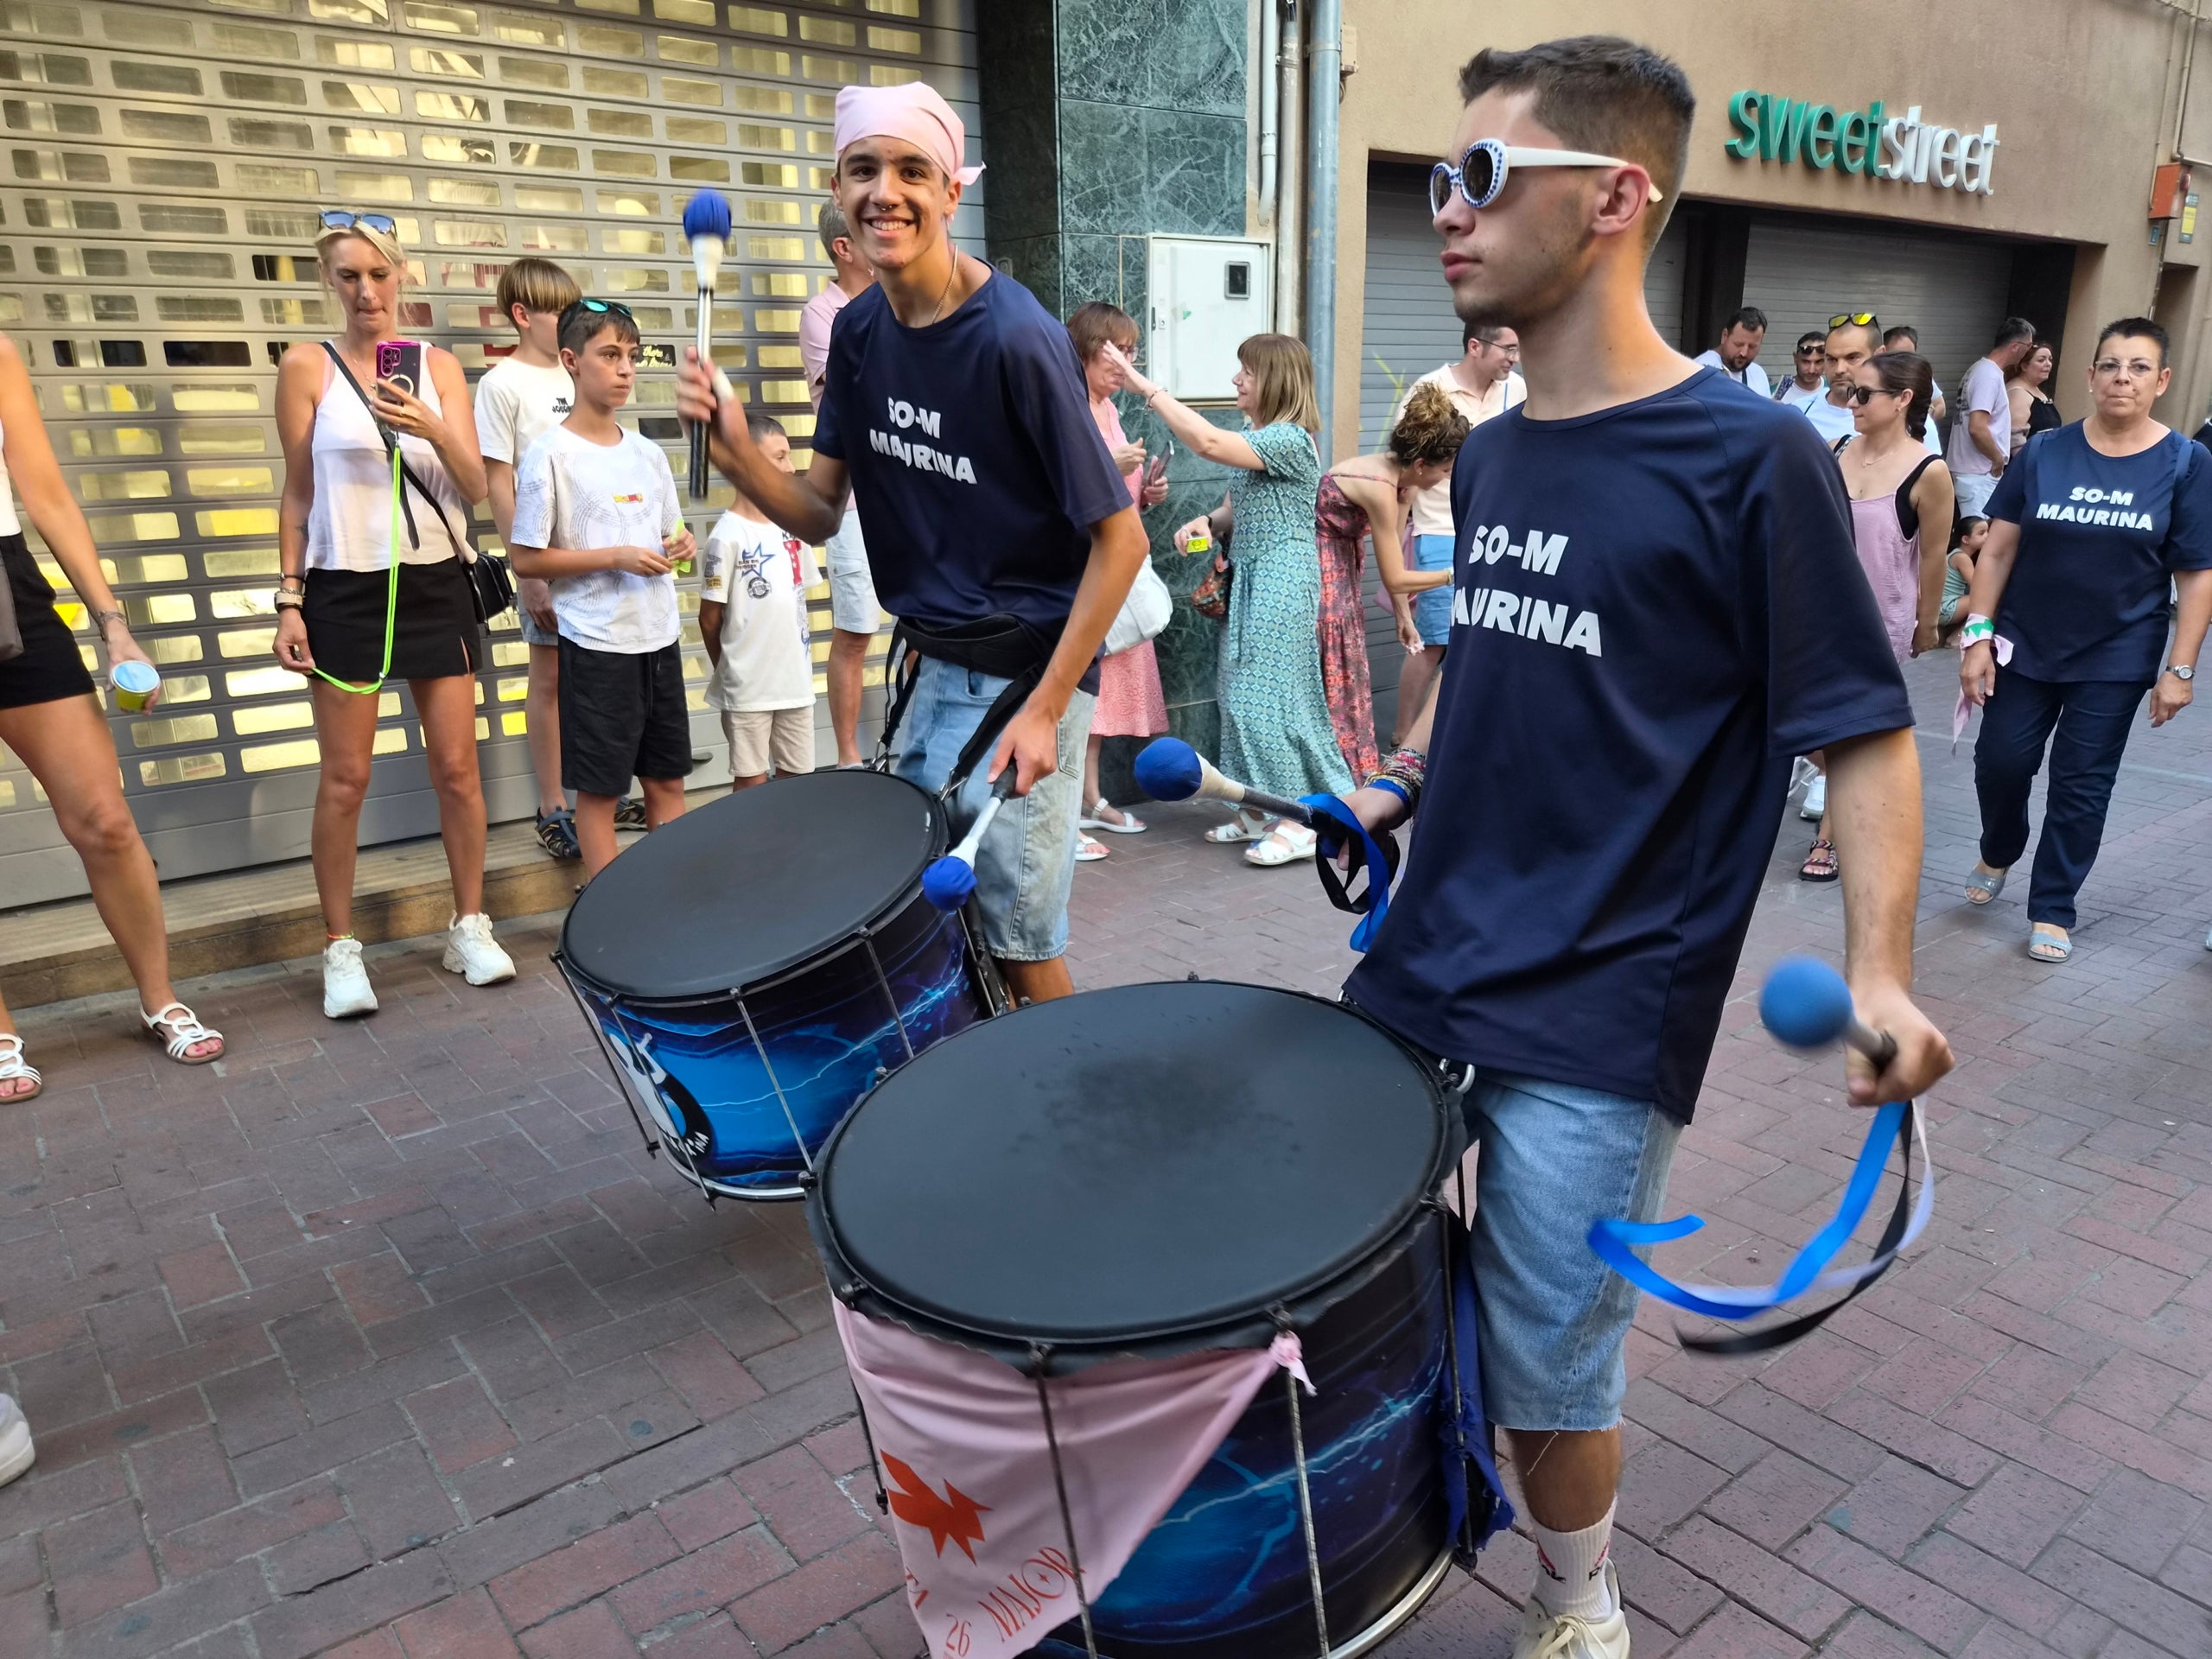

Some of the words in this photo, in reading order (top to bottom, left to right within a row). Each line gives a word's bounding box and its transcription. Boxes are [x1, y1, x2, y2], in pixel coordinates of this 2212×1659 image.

[2069, 486, 2133, 506] SO-M
[2036, 503, 2153, 531] MAURINA
[1469, 524, 1569, 576] SO-M
[977, 1546, 1086, 1643] MAJOR
